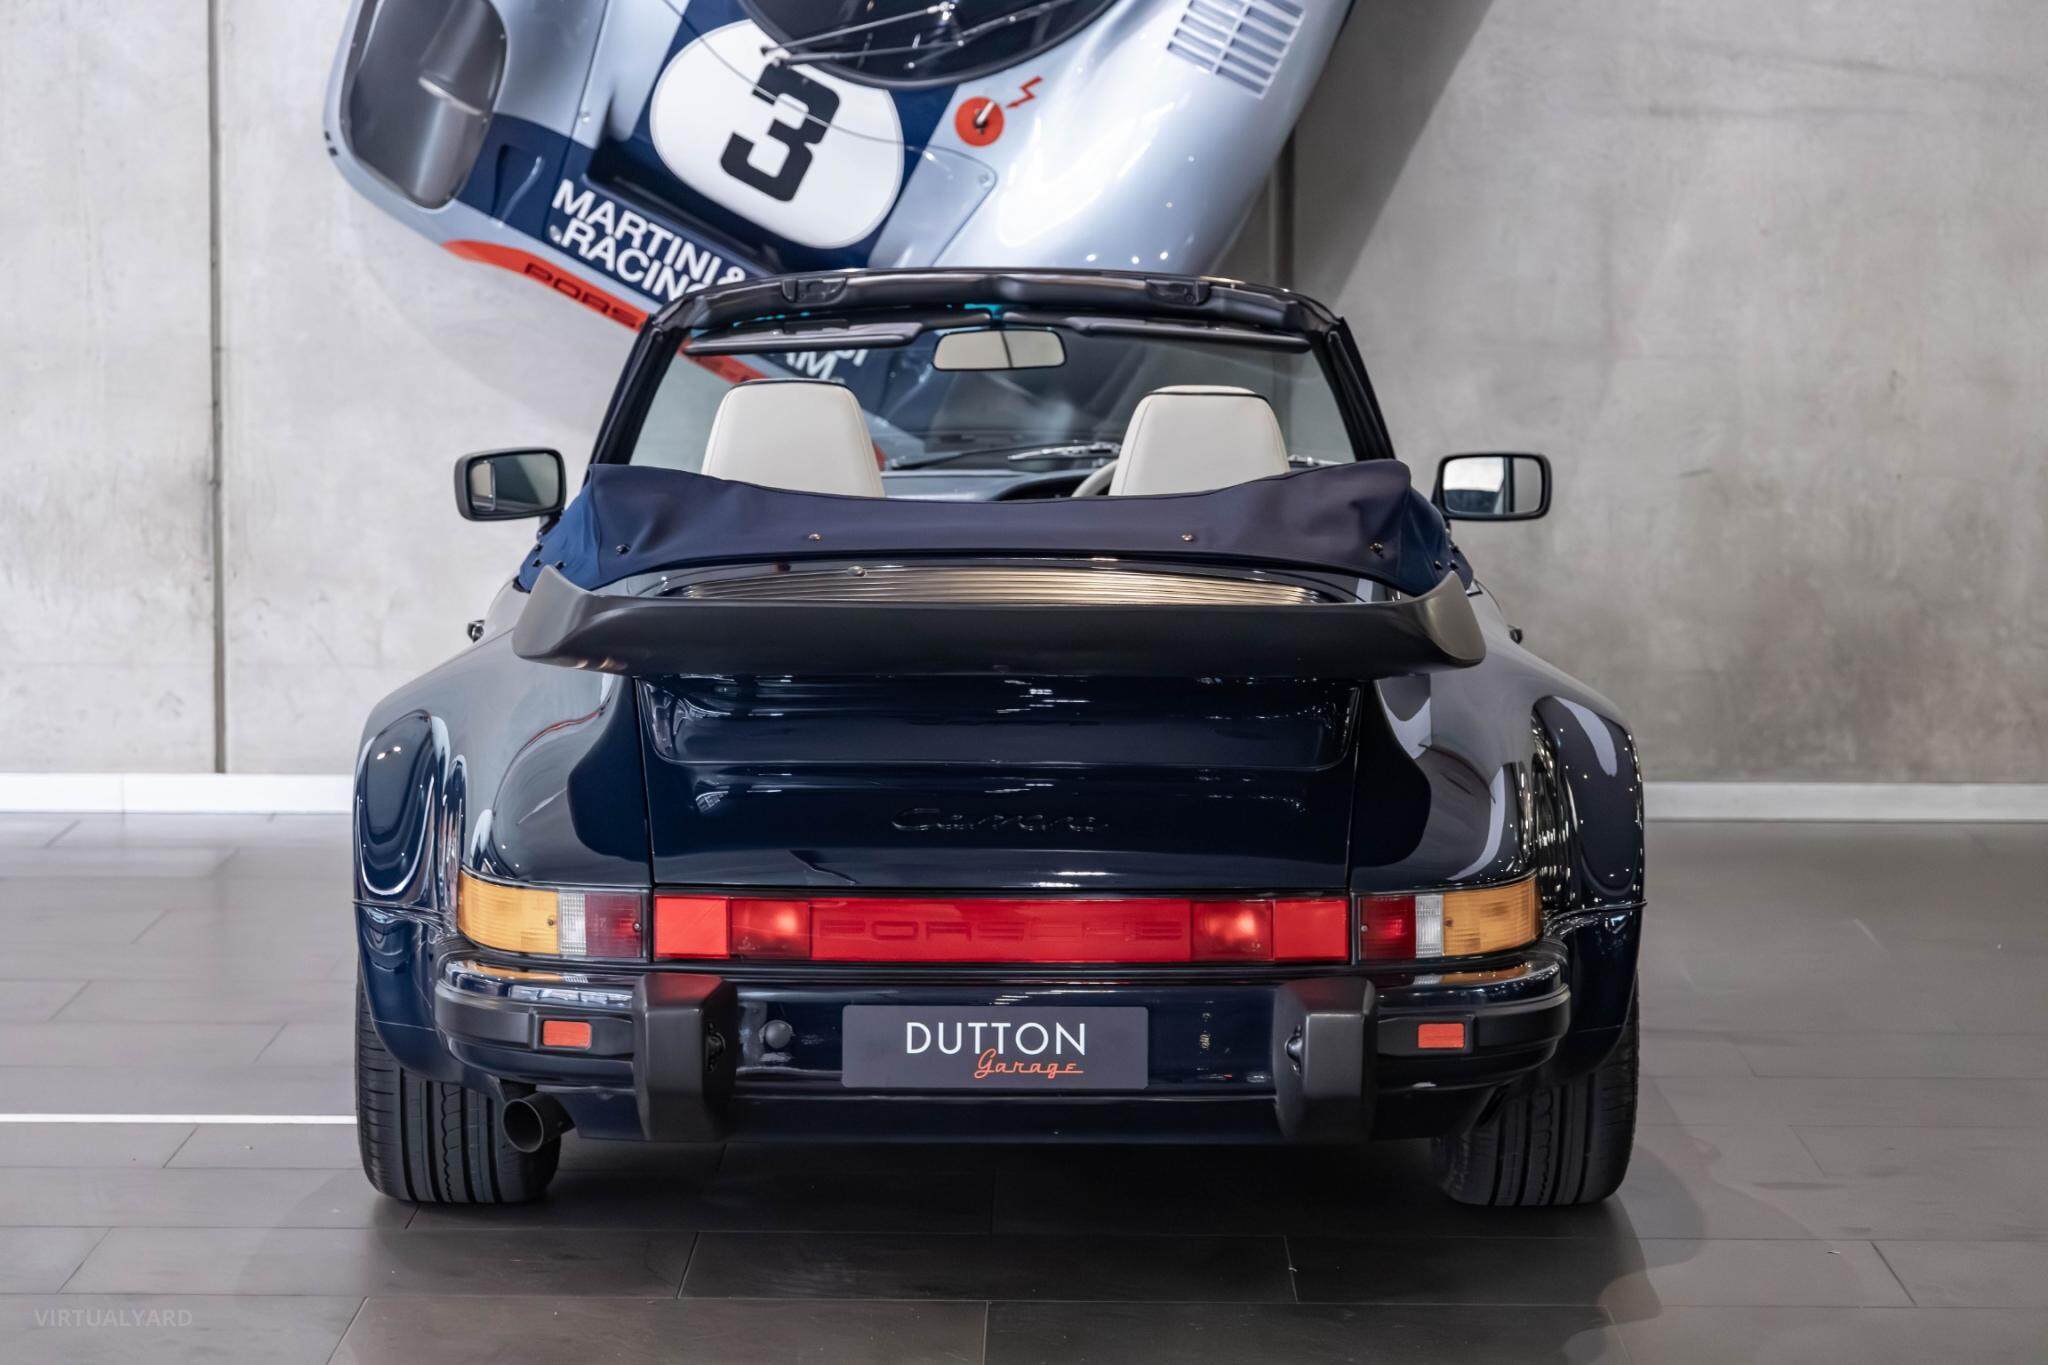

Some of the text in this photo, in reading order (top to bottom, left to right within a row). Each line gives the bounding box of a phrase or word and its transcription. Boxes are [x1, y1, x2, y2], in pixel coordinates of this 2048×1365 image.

[720, 62, 840, 201] 3
[552, 179, 722, 286] MARTINI
[524, 262, 637, 328] PORS
[891, 807, 1109, 832] Carrera
[818, 919, 1184, 942] PORSCHE
[906, 1021, 1086, 1055] DUTTON
[973, 1048, 1085, 1079] Garage
